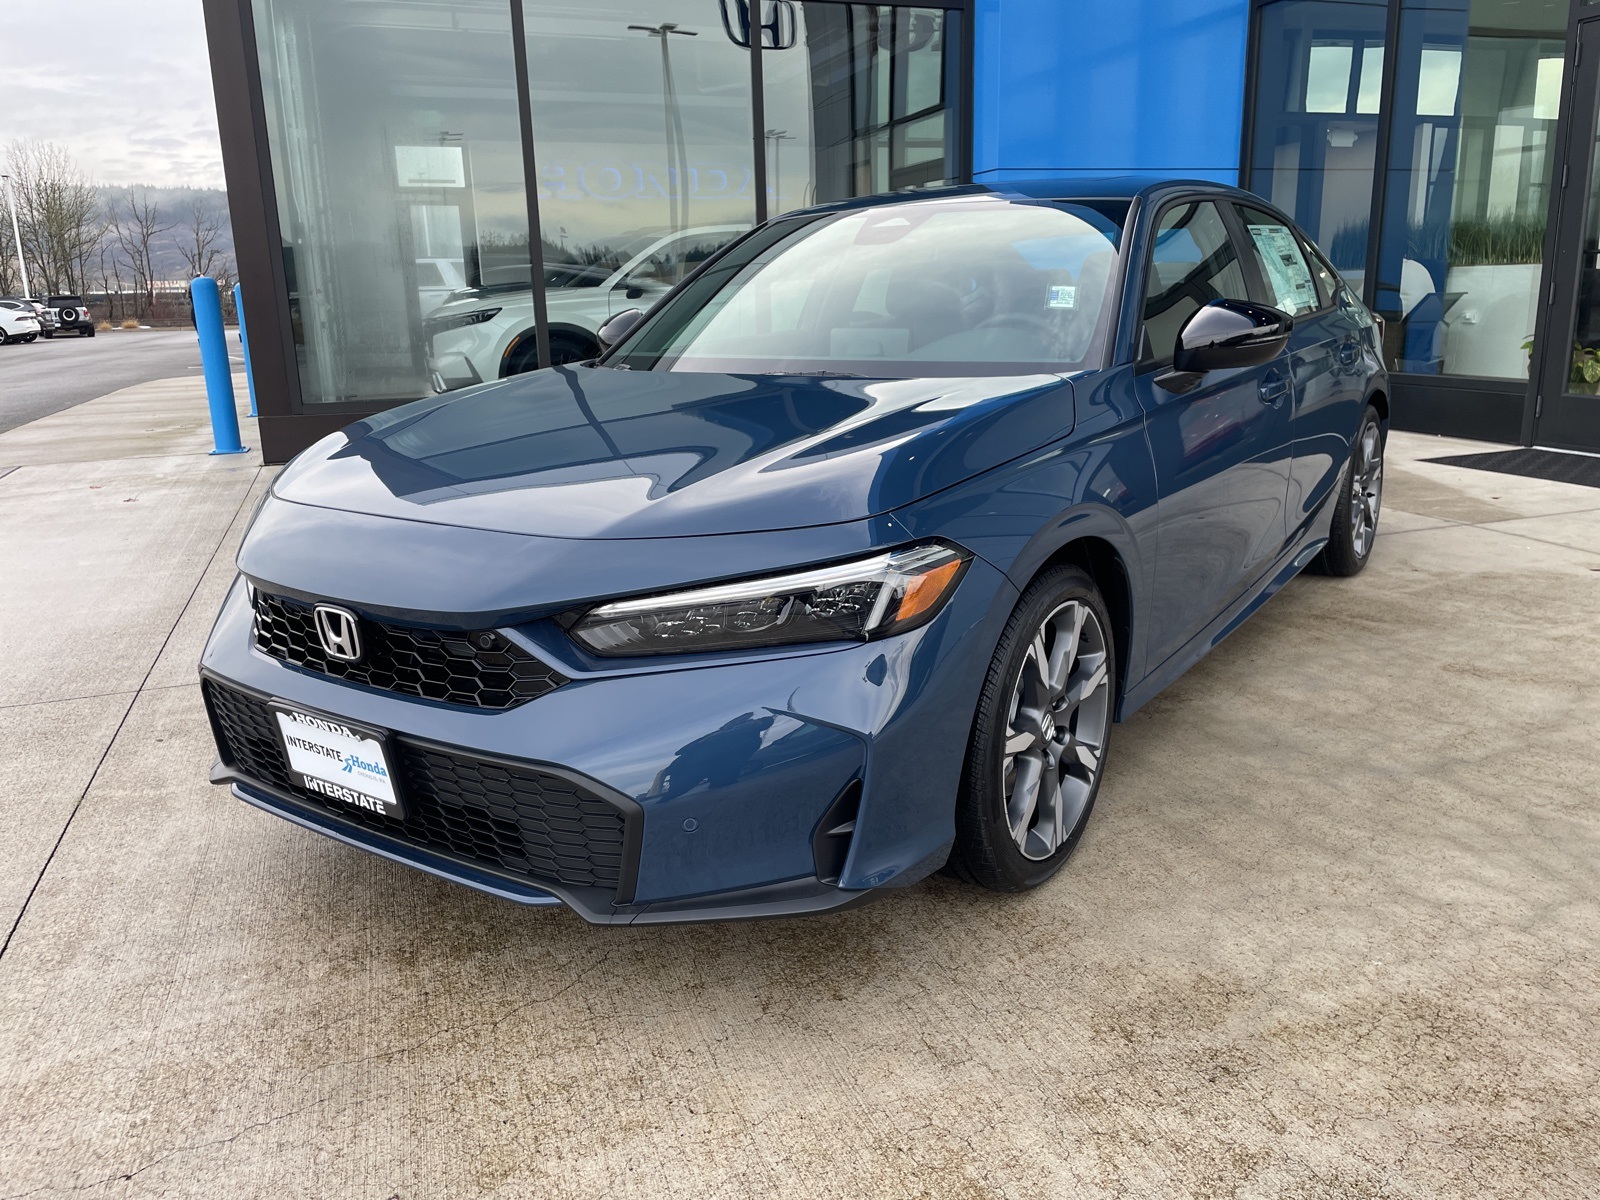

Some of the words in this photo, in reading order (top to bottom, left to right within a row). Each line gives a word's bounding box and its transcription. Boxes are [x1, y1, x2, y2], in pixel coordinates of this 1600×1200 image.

[292, 711, 356, 738] HONDA
[286, 735, 343, 762] INTERSTATE
[350, 754, 387, 777] Honda
[304, 775, 387, 815] INTERSTATE
